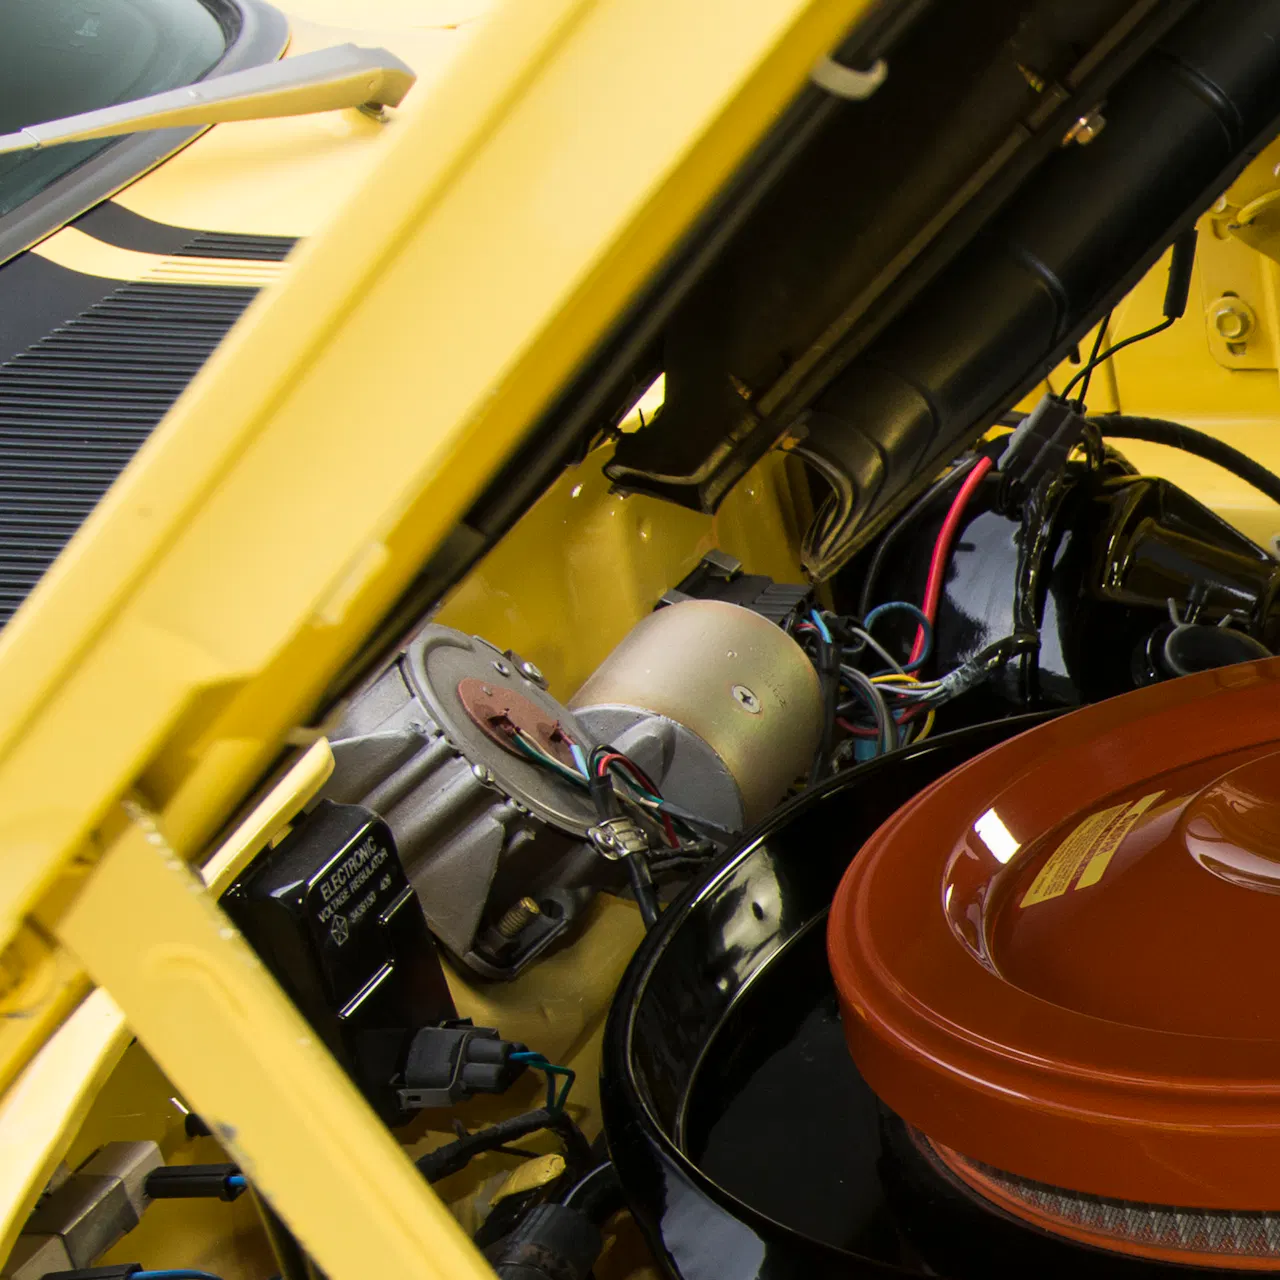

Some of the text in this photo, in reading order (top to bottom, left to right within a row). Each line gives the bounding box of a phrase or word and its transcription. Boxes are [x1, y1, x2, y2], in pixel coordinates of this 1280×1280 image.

[316, 847, 390, 924] VOLTAGE REGULATOR
[320, 834, 377, 901] ELECTRONIC
